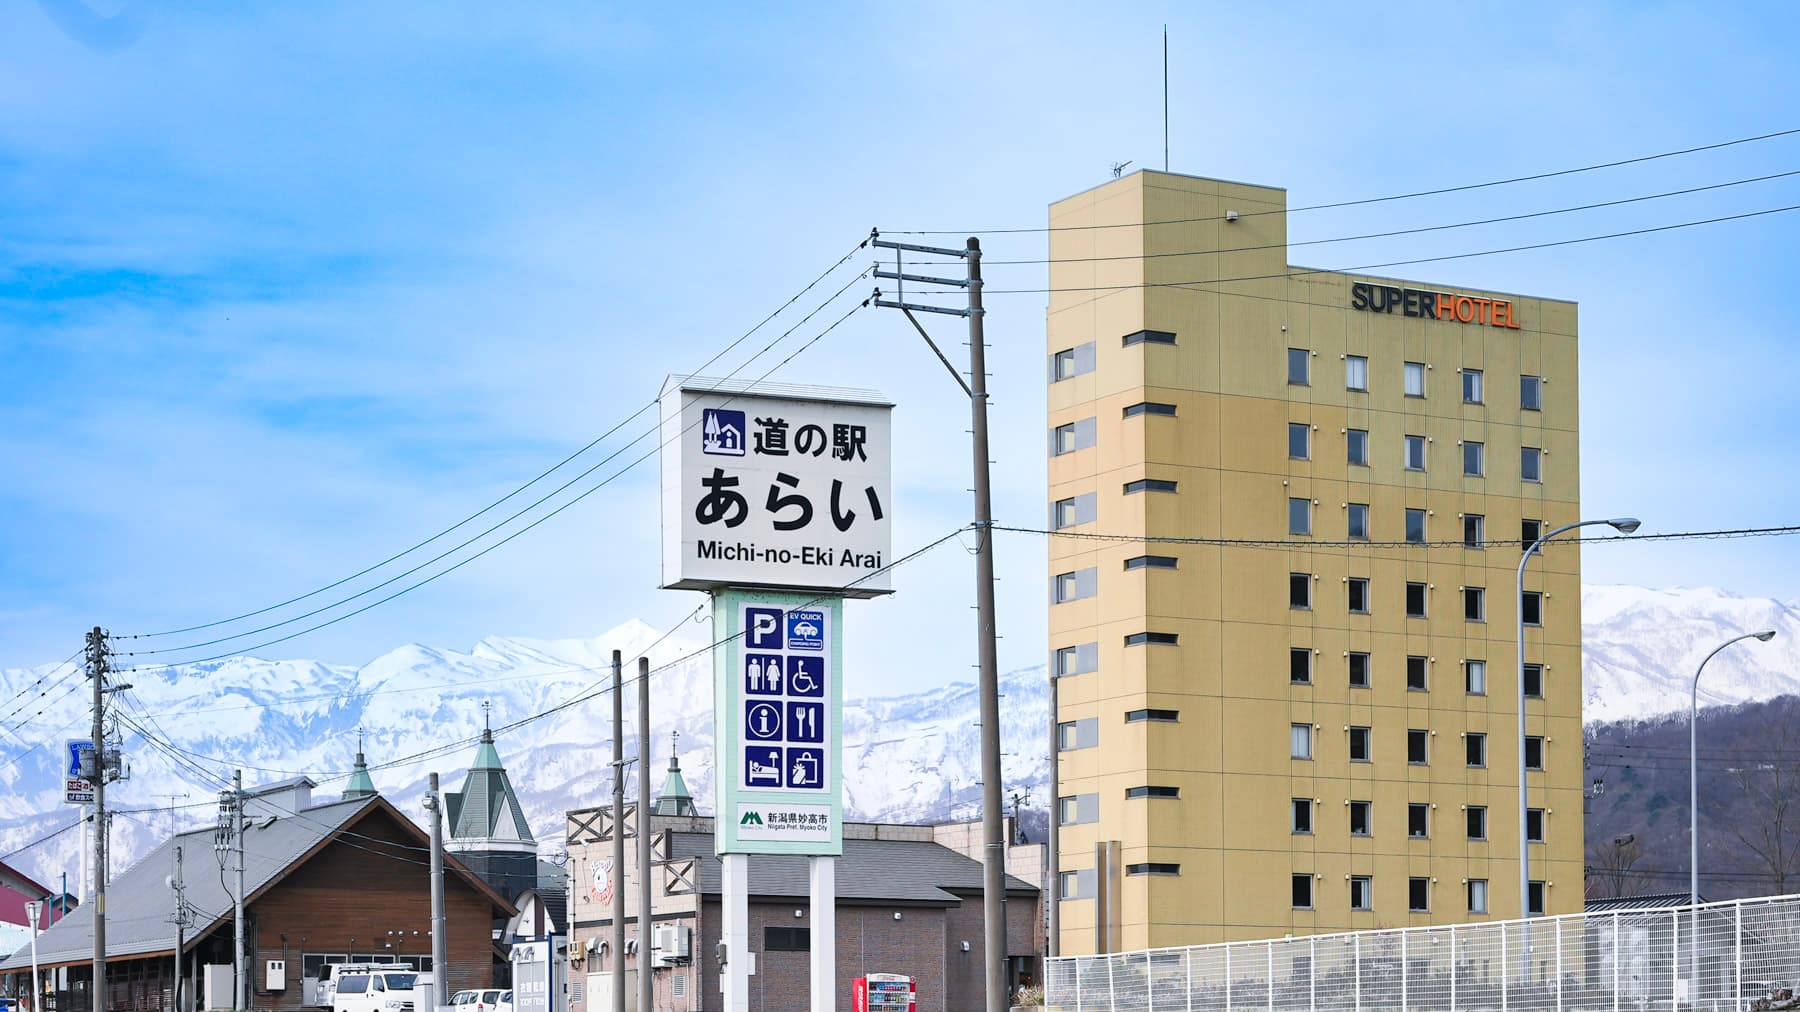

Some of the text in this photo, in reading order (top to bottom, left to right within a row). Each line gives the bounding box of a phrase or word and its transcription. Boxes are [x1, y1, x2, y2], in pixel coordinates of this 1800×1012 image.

[753, 417, 867, 462] 道の駅
[695, 467, 883, 532] あらい
[697, 540, 881, 568] Michi-no-Eki Arai
[754, 613, 777, 645] P
[789, 612, 822, 621] EV QUICK
[768, 812, 828, 824] 新潟県妙高市
[817, 824, 828, 832] City
